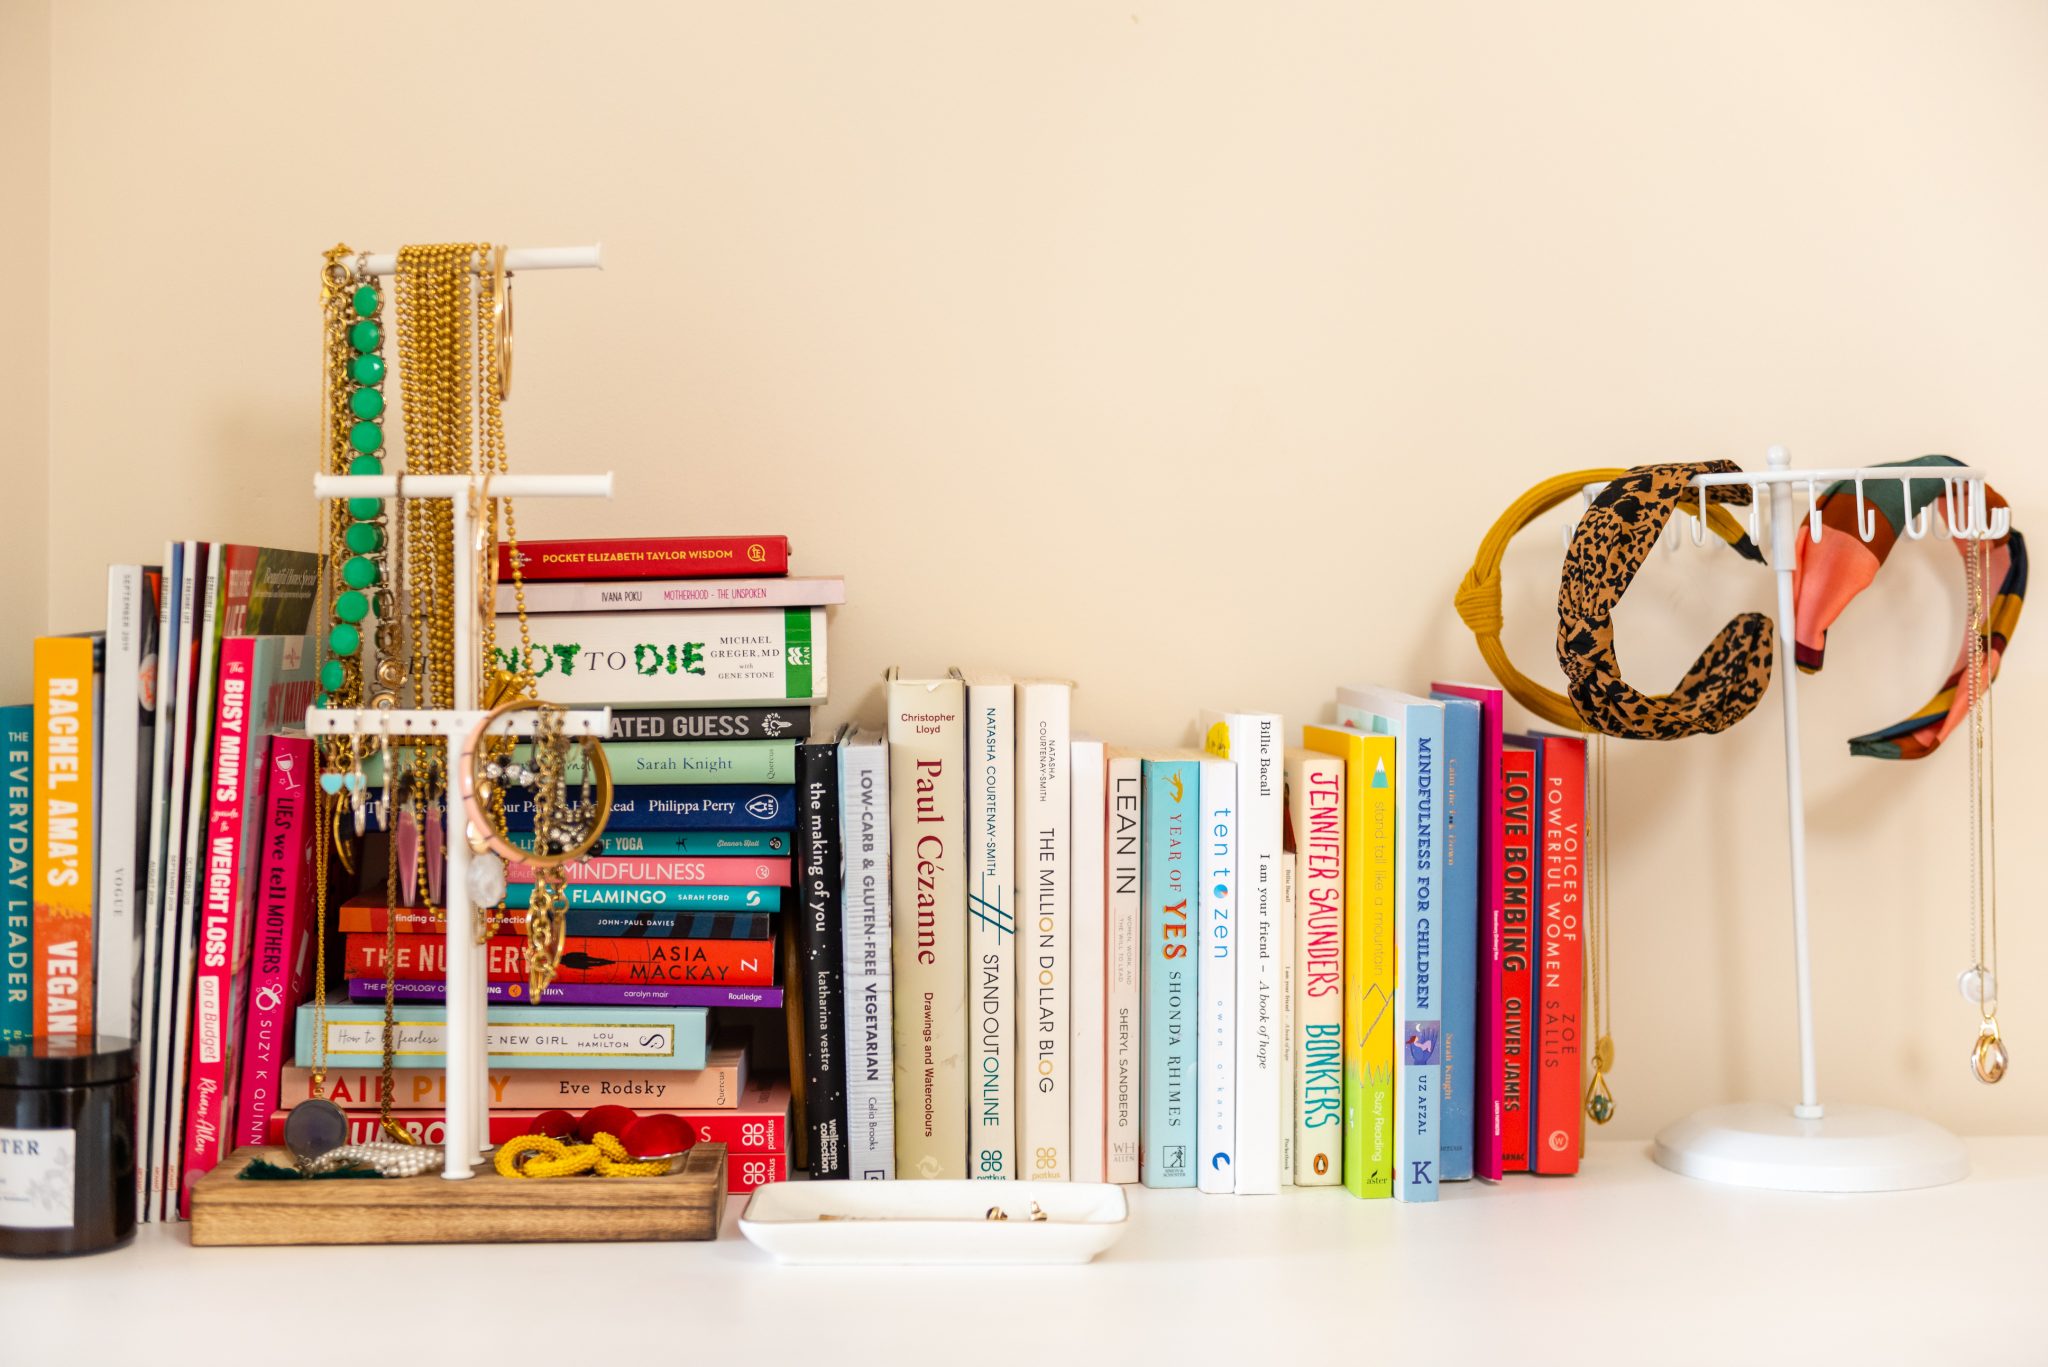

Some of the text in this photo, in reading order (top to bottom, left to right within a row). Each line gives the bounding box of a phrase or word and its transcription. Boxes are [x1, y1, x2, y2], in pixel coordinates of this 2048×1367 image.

[542, 550, 733, 563] POCKET ELIZABETH TAYLOR WISDOM
[601, 591, 642, 603] IVANA POKU
[663, 588, 767, 600] MOTHERHOOD UNSPOKEN
[720, 636, 772, 645] MICHAEL
[584, 652, 626, 671] TO
[635, 642, 706, 677] DIE
[718, 671, 775, 680] GENE STONE
[8, 732, 29, 742] THE
[672, 715, 750, 737] GUESS
[901, 713, 955, 725] Christopher
[916, 725, 941, 735] Lloyd
[216, 679, 245, 803] BUSY MUM'S
[1260, 721, 1271, 796] Billie Bacall
[636, 757, 732, 773] Sarah Knight
[766, 749, 775, 780] Quercus
[1039, 720, 1048, 803] COURTENAY-SMITH
[1048, 740, 1056, 781] NATASHA
[47, 678, 79, 887] RACHEL AMA'S
[986, 707, 996, 876] NATASHA COURTENAY-SMITH
[648, 799, 736, 815] Philippa Perry
[1374, 800, 1385, 840] stand
[616, 837, 644, 850] YOGA
[1116, 778, 1137, 894] LEAN IN
[563, 862, 706, 881] MINDFULNESS
[808, 782, 830, 932] the making of you
[916, 758, 945, 965] Paul Cézanne
[1260, 863, 1269, 883] am
[1416, 736, 1432, 1010] MINDFULNESS FOR CHILDREN
[1503, 770, 1529, 973] LOVE BOMBING
[8, 750, 29, 1003] EVERYDAY LEADER
[113, 867, 124, 917] VOGUE
[262, 798, 295, 975] LIES we tell MOTHERS
[1162, 813, 1187, 961] YEAR OF YES
[1213, 808, 1232, 959] ten zen
[1307, 772, 1340, 998] JENNIFER SAUNDERS
[1545, 777, 1562, 987] POWERFUL WOMEN
[1563, 823, 1577, 941] VOICES OF
[204, 837, 234, 968] WEIGHT LOSS
[573, 889, 667, 904] FLAMINGO
[1257, 887, 1269, 917] your
[395, 914, 427, 924] finding
[598, 919, 675, 928] JOHN-PAUL DAVIES
[861, 769, 879, 1081] LOW-CARB GLUTEN-FREE VEGETARIAN
[362, 947, 411, 968] THE
[651, 946, 708, 962] ASIA
[1259, 921, 1270, 959] friend
[629, 964, 730, 981] MACKAY
[1038, 828, 1055, 1094] THE MILLION DOLLAR BLOG
[363, 982, 379, 991] THE
[623, 990, 669, 1000] carolyn mair
[728, 992, 763, 1001] Routledge
[818, 971, 831, 1072] katharina vestre
[1258, 996, 1270, 1024] book
[500, 1035, 530, 1045] NEW
[535, 1035, 569, 1045] GIRL
[578, 1041, 629, 1049] HAMILTON
[983, 954, 999, 1126] STANDOUTONLINE
[1167, 971, 1182, 1127] SHONDA RHIMES
[1545, 1000, 1560, 1069] SALLIS
[1562, 1014, 1576, 1055] ZOË
[922, 992, 935, 1137] Drawings and Watercolours
[1118, 1008, 1128, 1128] SHERYL SANDBERG
[1256, 1041, 1270, 1070] hope
[1504, 997, 1521, 1112] OLIVER JAMES
[250, 1019, 273, 1145] SUZY K QUINN
[308, 1075, 396, 1103] FAIR
[559, 1081, 667, 1098] Eve Rodsky
[716, 1070, 726, 1106] Quercus
[1304, 1023, 1341, 1129] BONKERS
[1418, 1074, 1428, 1136] UZ AFZAL
[767, 1119, 776, 1150] piatkus
[829, 1118, 840, 1170] wellcome
[867, 1122, 879, 1152] Brooks
[1372, 1091, 1385, 1163] Suzy Reading
[820, 1122, 831, 1174] collection
[1113, 1142, 1135, 1153] WH
[1366, 1176, 1388, 1185] aster
[1411, 1160, 1433, 1185] K
